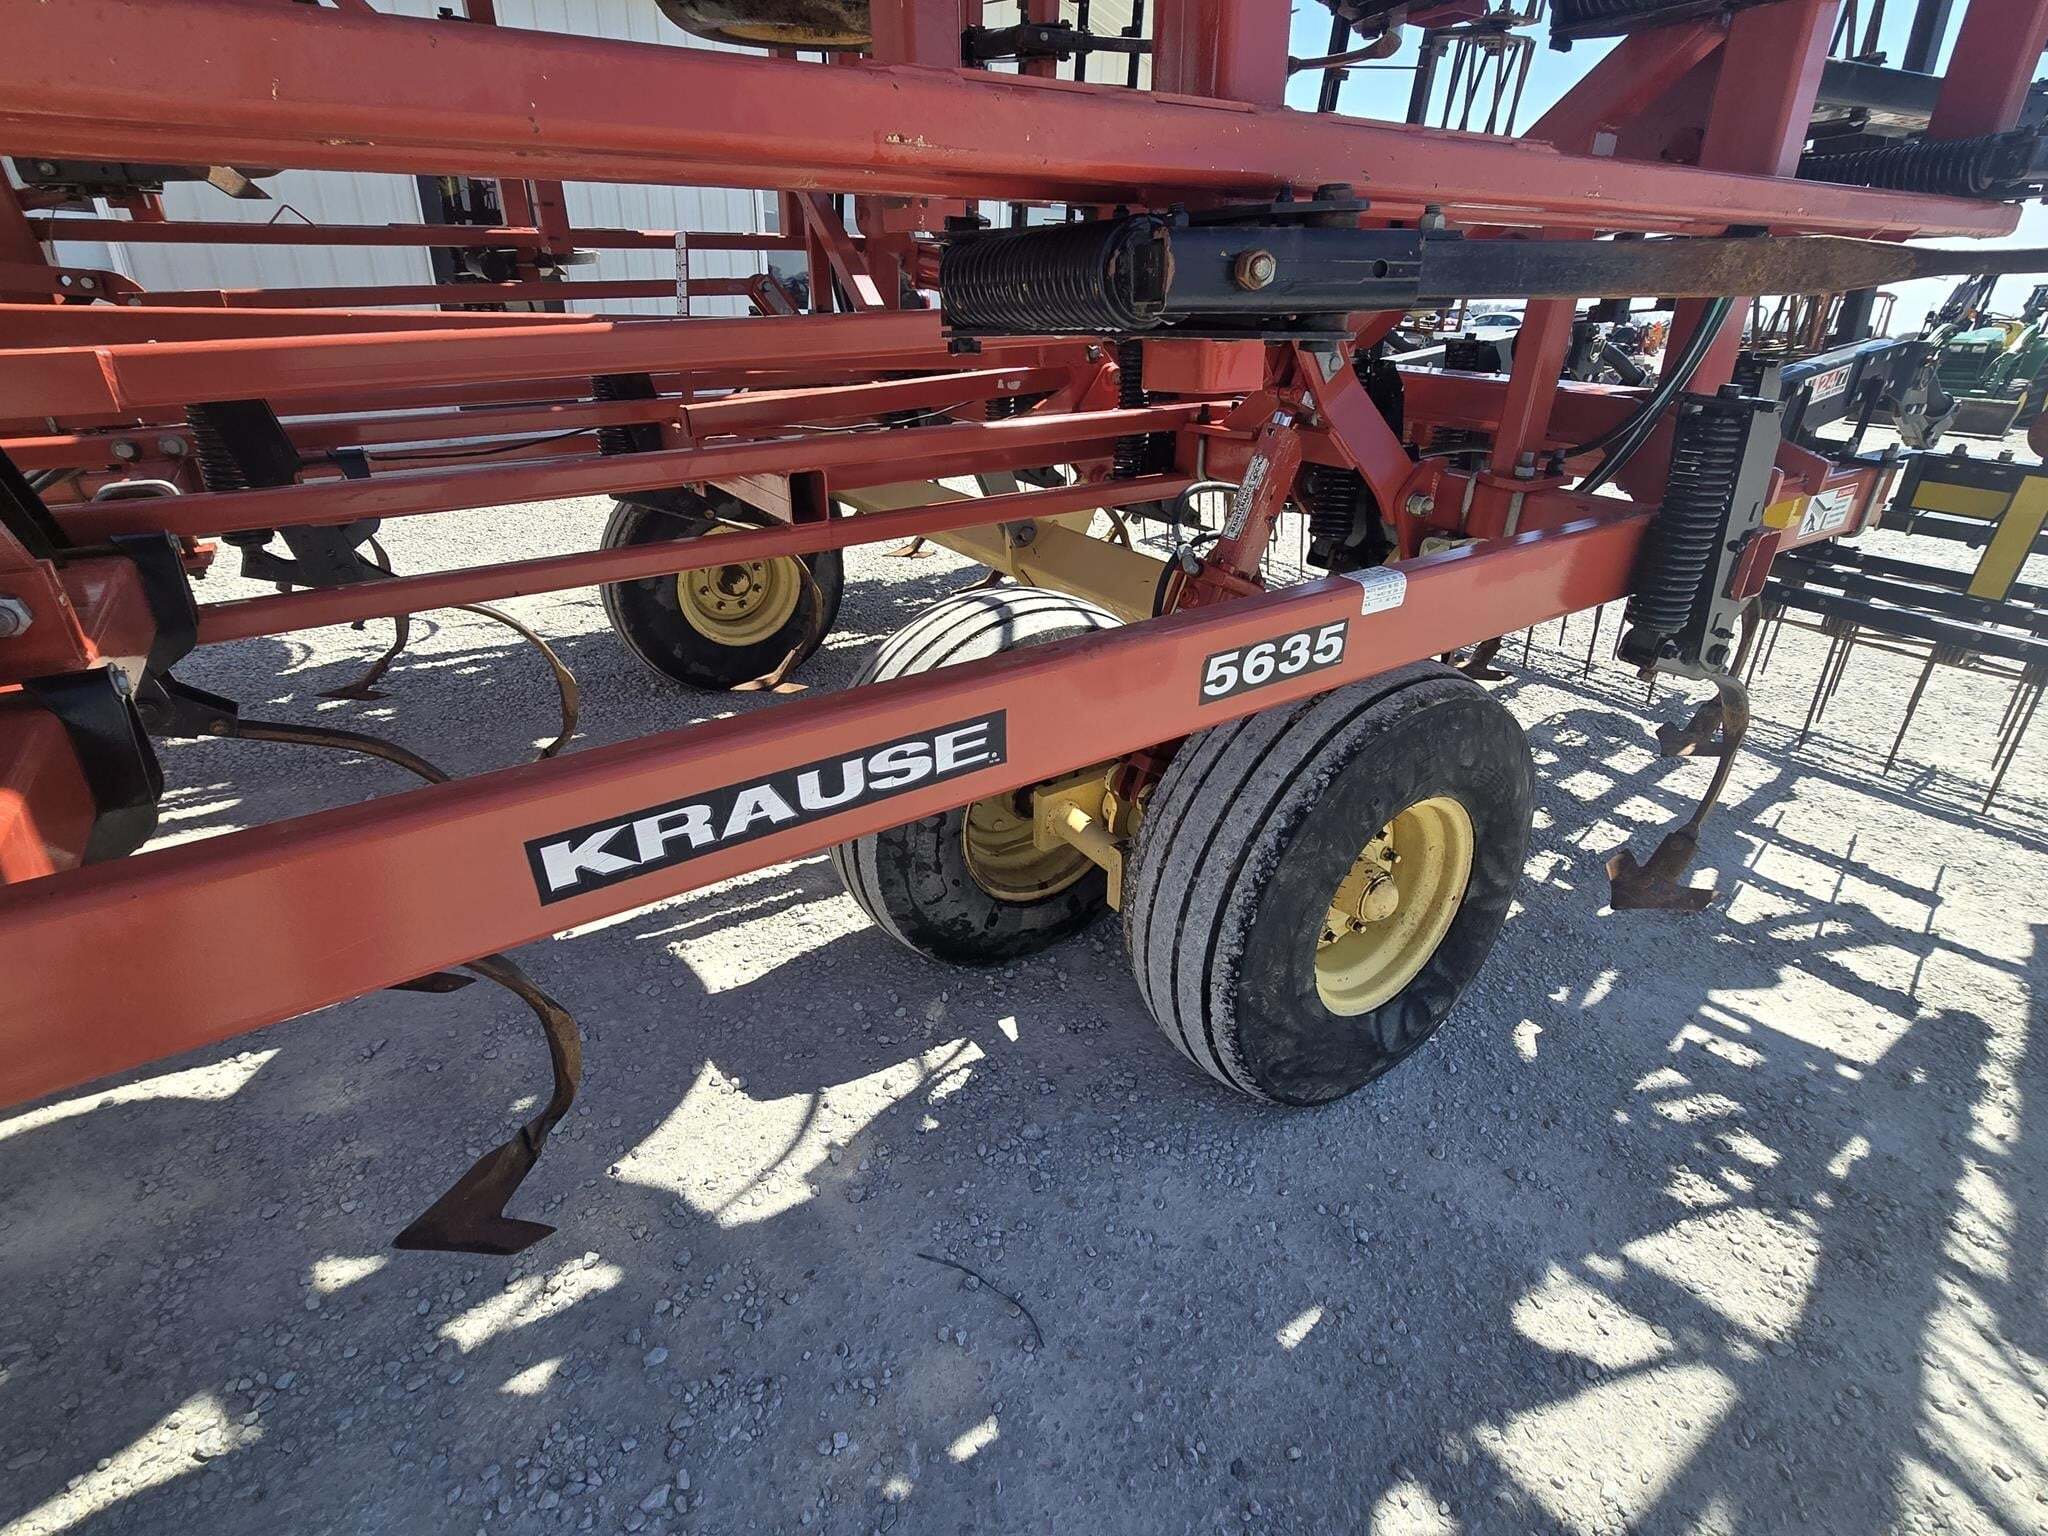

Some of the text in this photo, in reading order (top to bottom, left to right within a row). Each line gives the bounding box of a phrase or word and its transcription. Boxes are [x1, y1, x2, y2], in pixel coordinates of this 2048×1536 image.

[1230, 483, 1255, 533] MAINTENANCE
[1203, 621, 1346, 697] 5635
[540, 721, 990, 893] KRAUSE
